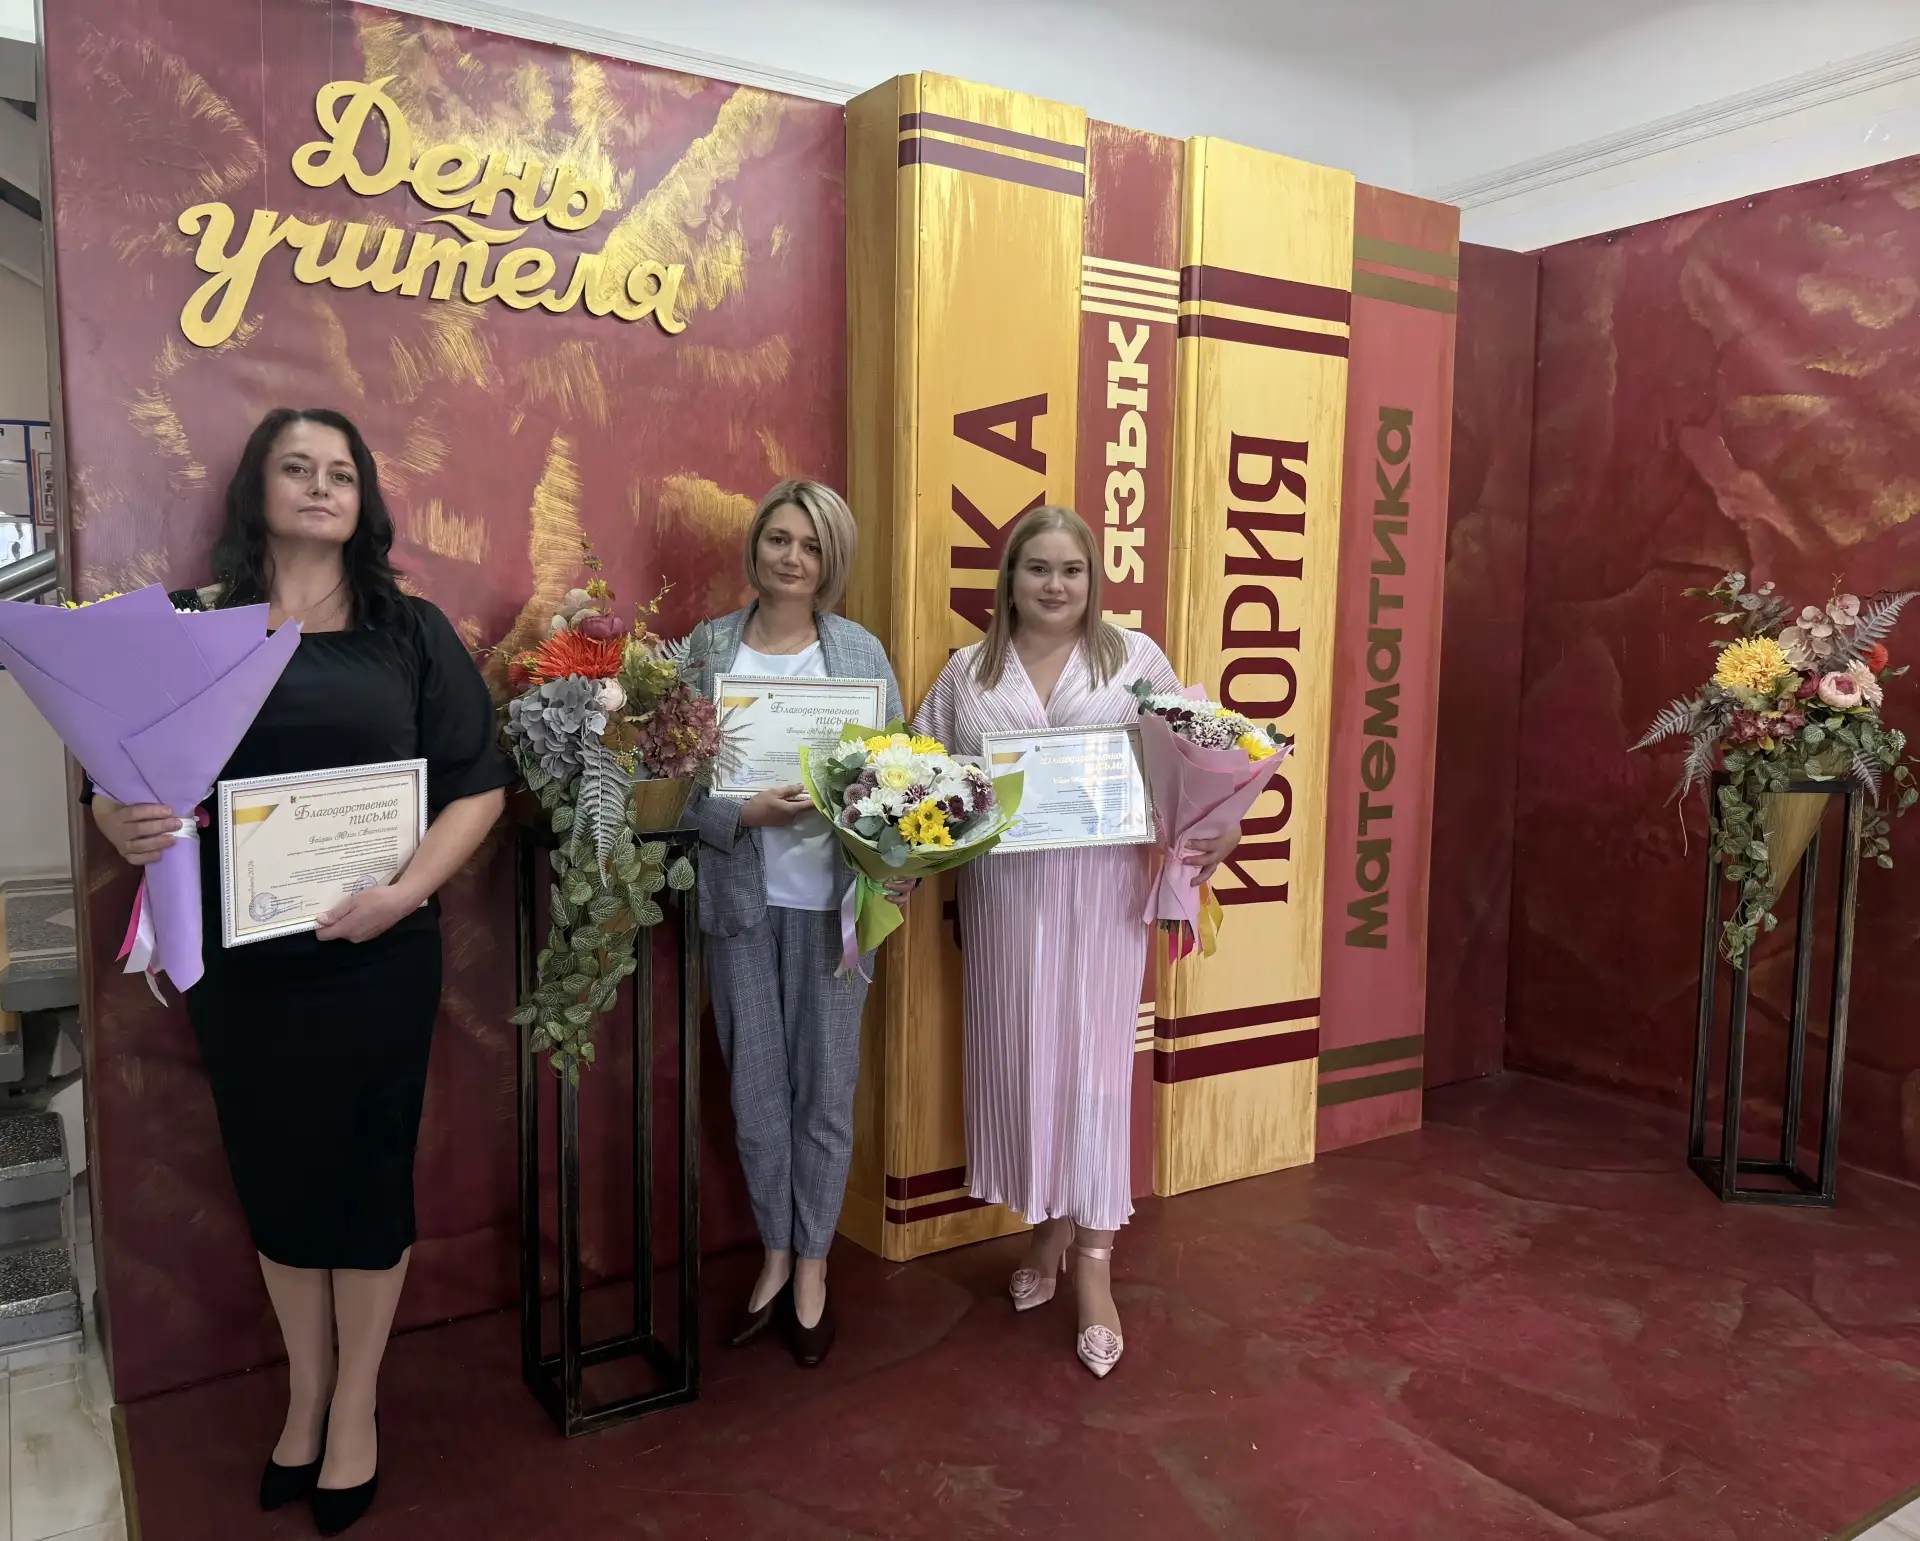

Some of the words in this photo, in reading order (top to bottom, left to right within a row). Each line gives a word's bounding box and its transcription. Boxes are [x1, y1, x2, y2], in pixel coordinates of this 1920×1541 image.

[291, 75, 606, 231] День
[1103, 320, 1150, 584] ЯЗЫК
[770, 701, 860, 717] Благодарственное
[1212, 430, 1309, 905] ИСОРИЯ
[294, 798, 399, 821] Благодарственное
[349, 809, 398, 826] письмо
